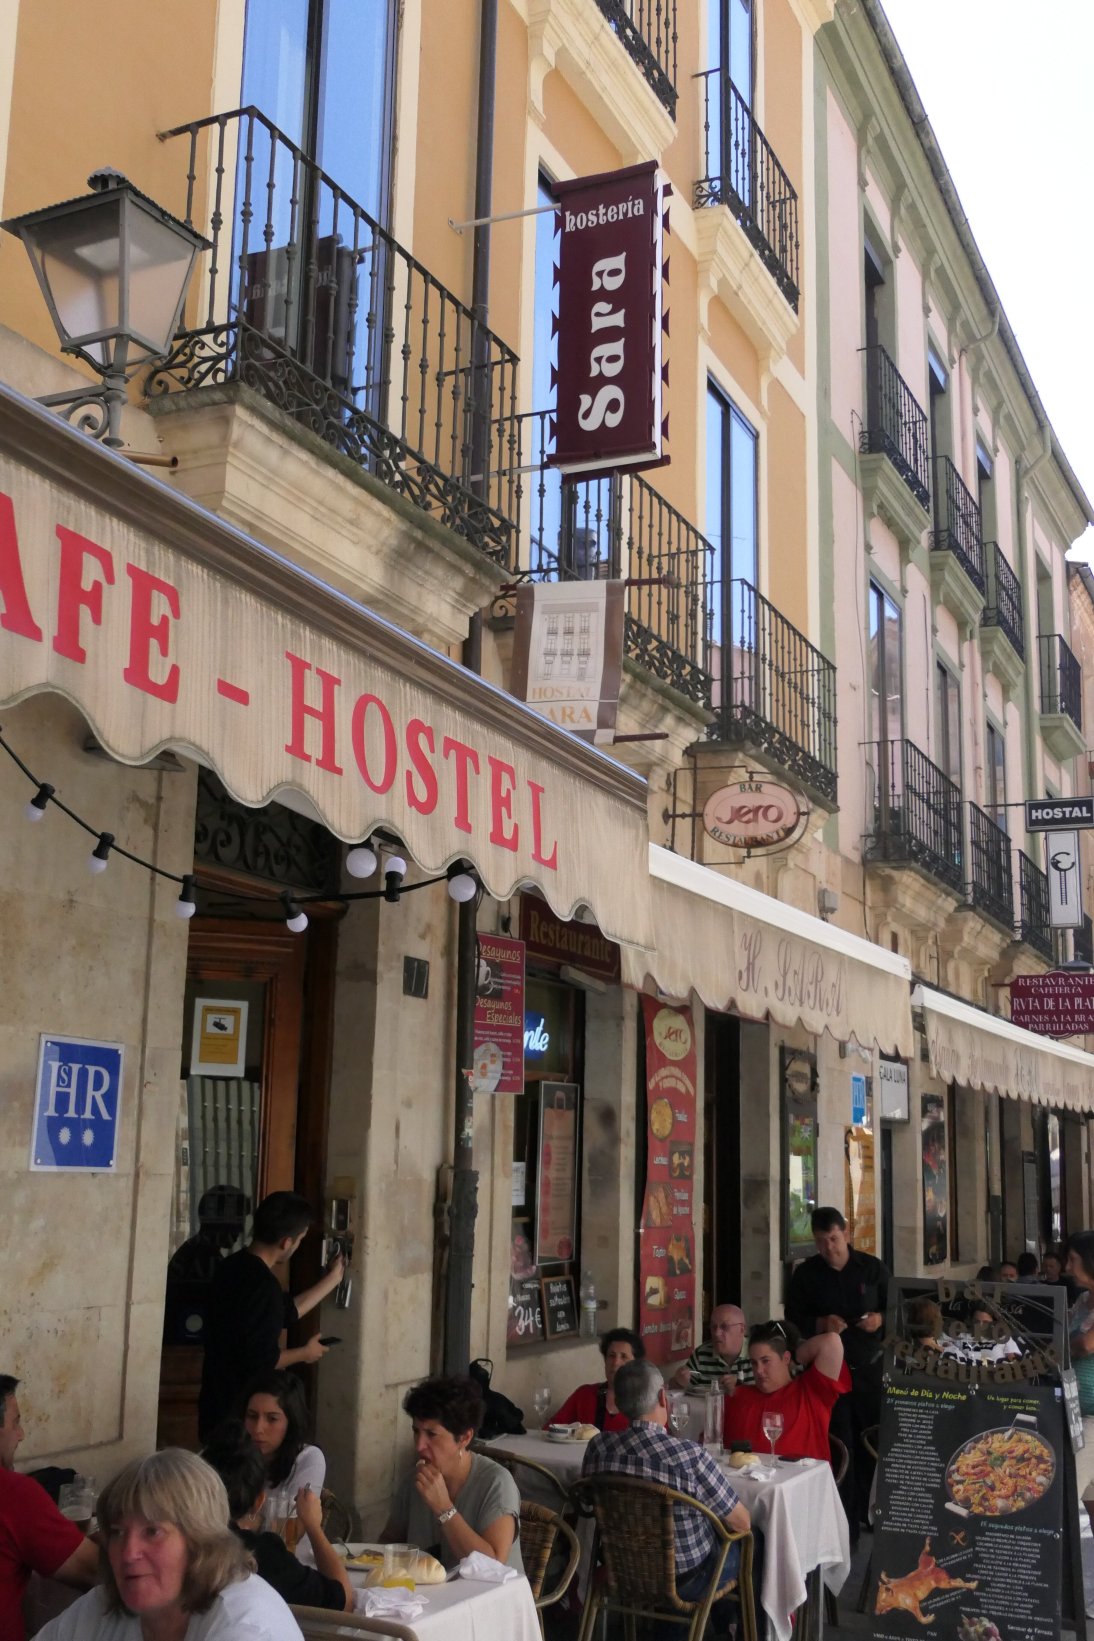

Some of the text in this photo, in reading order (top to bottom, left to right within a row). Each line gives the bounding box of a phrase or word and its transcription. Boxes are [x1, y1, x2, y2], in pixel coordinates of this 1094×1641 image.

[564, 196, 645, 233] hostería
[577, 251, 627, 431] Sara
[285, 651, 558, 870] HOSTEL
[739, 783, 763, 793] BAR
[1031, 806, 1091, 820] HOSTAL
[710, 825, 790, 847] RESTAURANTE
[1043, 997, 1056, 1010] DE
[1059, 998, 1071, 1010] LA
[486, 1010, 522, 1027] Especiales
[1012, 1014, 1049, 1022] CARNES
[1051, 1014, 1057, 1022] A
[1060, 1014, 1071, 1022] LA
[887, 1387, 909, 1395] Menú
[910, 1388, 919, 1396] de
[941, 1391, 967, 1401] Noche
